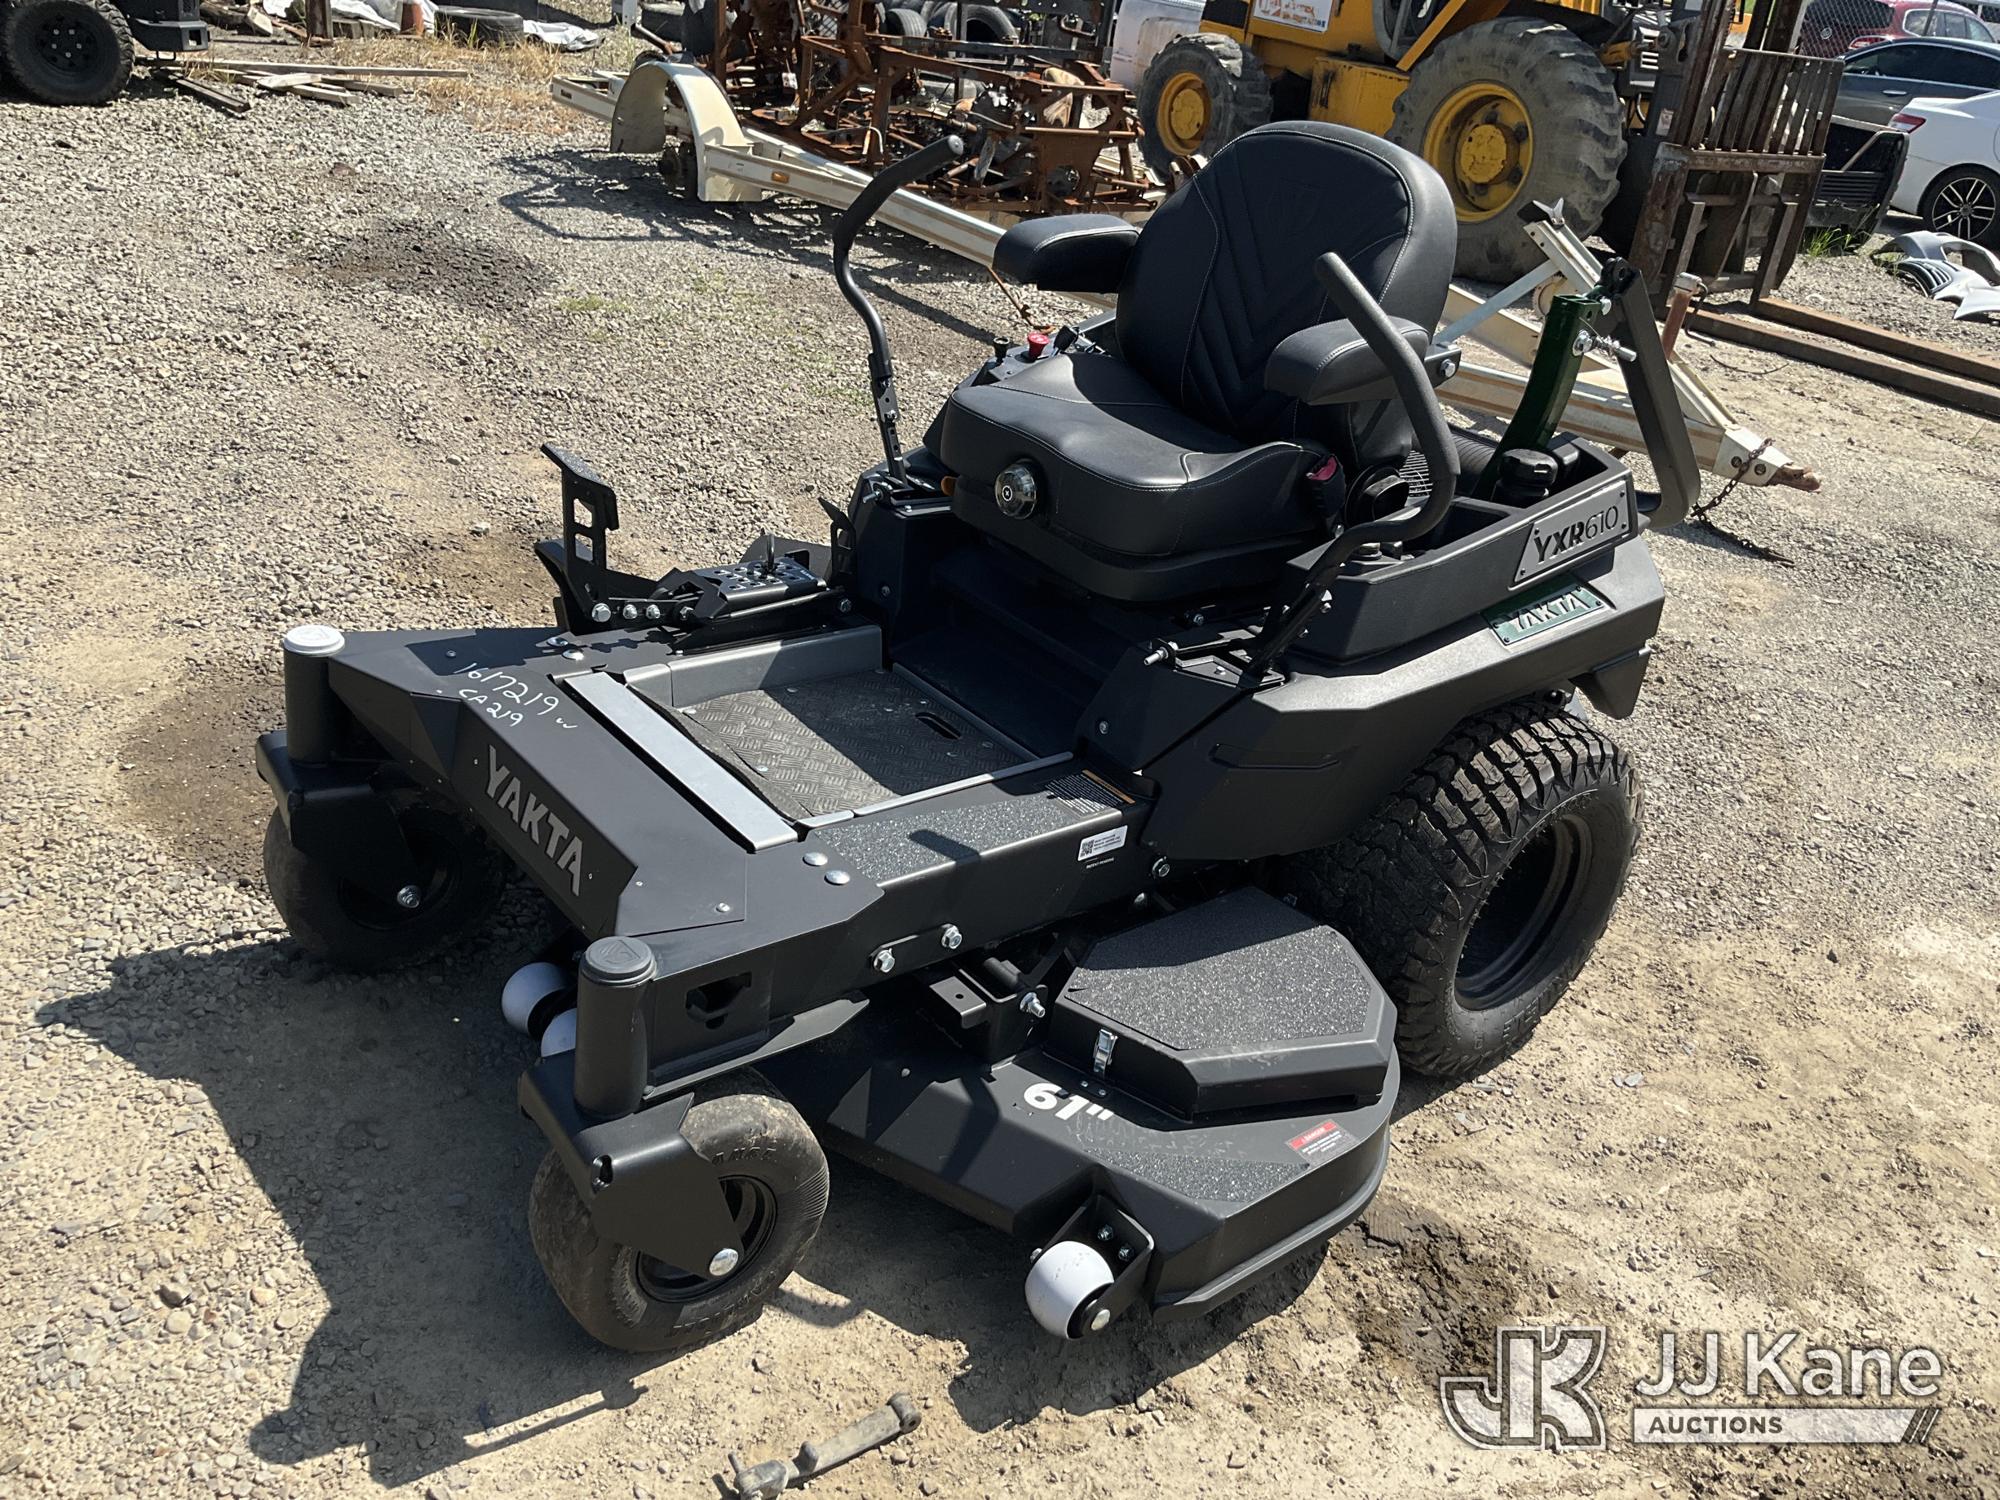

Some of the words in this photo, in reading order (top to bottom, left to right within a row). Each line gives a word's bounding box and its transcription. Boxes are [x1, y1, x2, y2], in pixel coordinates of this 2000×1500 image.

[1533, 505, 1619, 564] YXR610
[1510, 591, 1591, 632] YAKTA
[453, 662, 559, 716] 1617219
[486, 744, 582, 897] YAKTA
[1023, 1082, 1114, 1121] 61"
